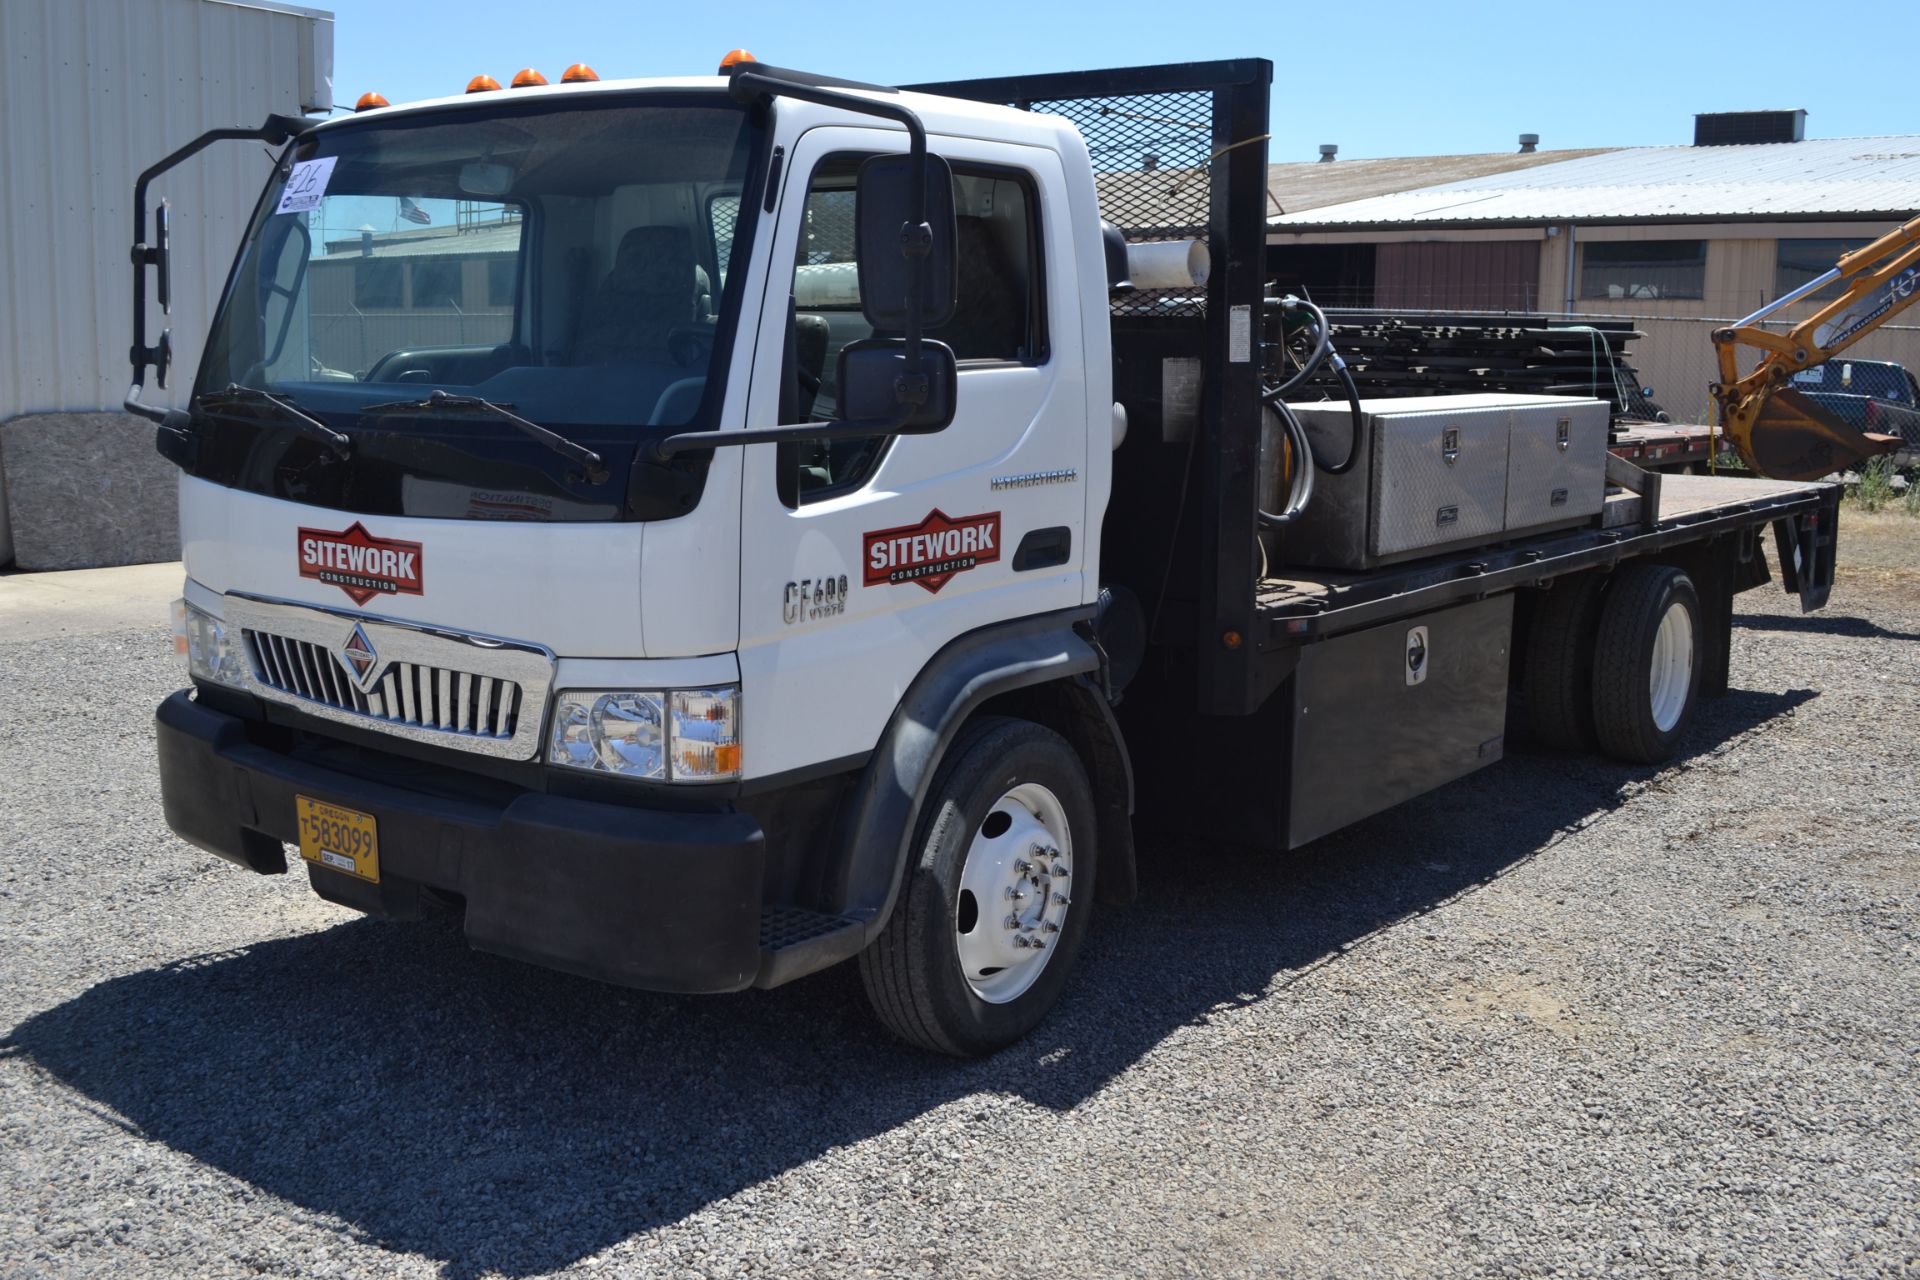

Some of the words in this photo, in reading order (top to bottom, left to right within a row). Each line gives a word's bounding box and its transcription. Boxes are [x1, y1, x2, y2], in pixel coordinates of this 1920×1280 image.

[292, 164, 322, 195] 26
[991, 468, 1077, 491] INTERNATIONAL
[303, 538, 416, 580] SITEWORK
[870, 523, 994, 570] SITEWORK
[320, 571, 397, 591] CONSTRUCTION
[890, 558, 976, 581] CONSTRUCTION
[783, 574, 848, 624] CF600
[320, 806, 350, 822] OREGON
[301, 814, 372, 858] T583099
